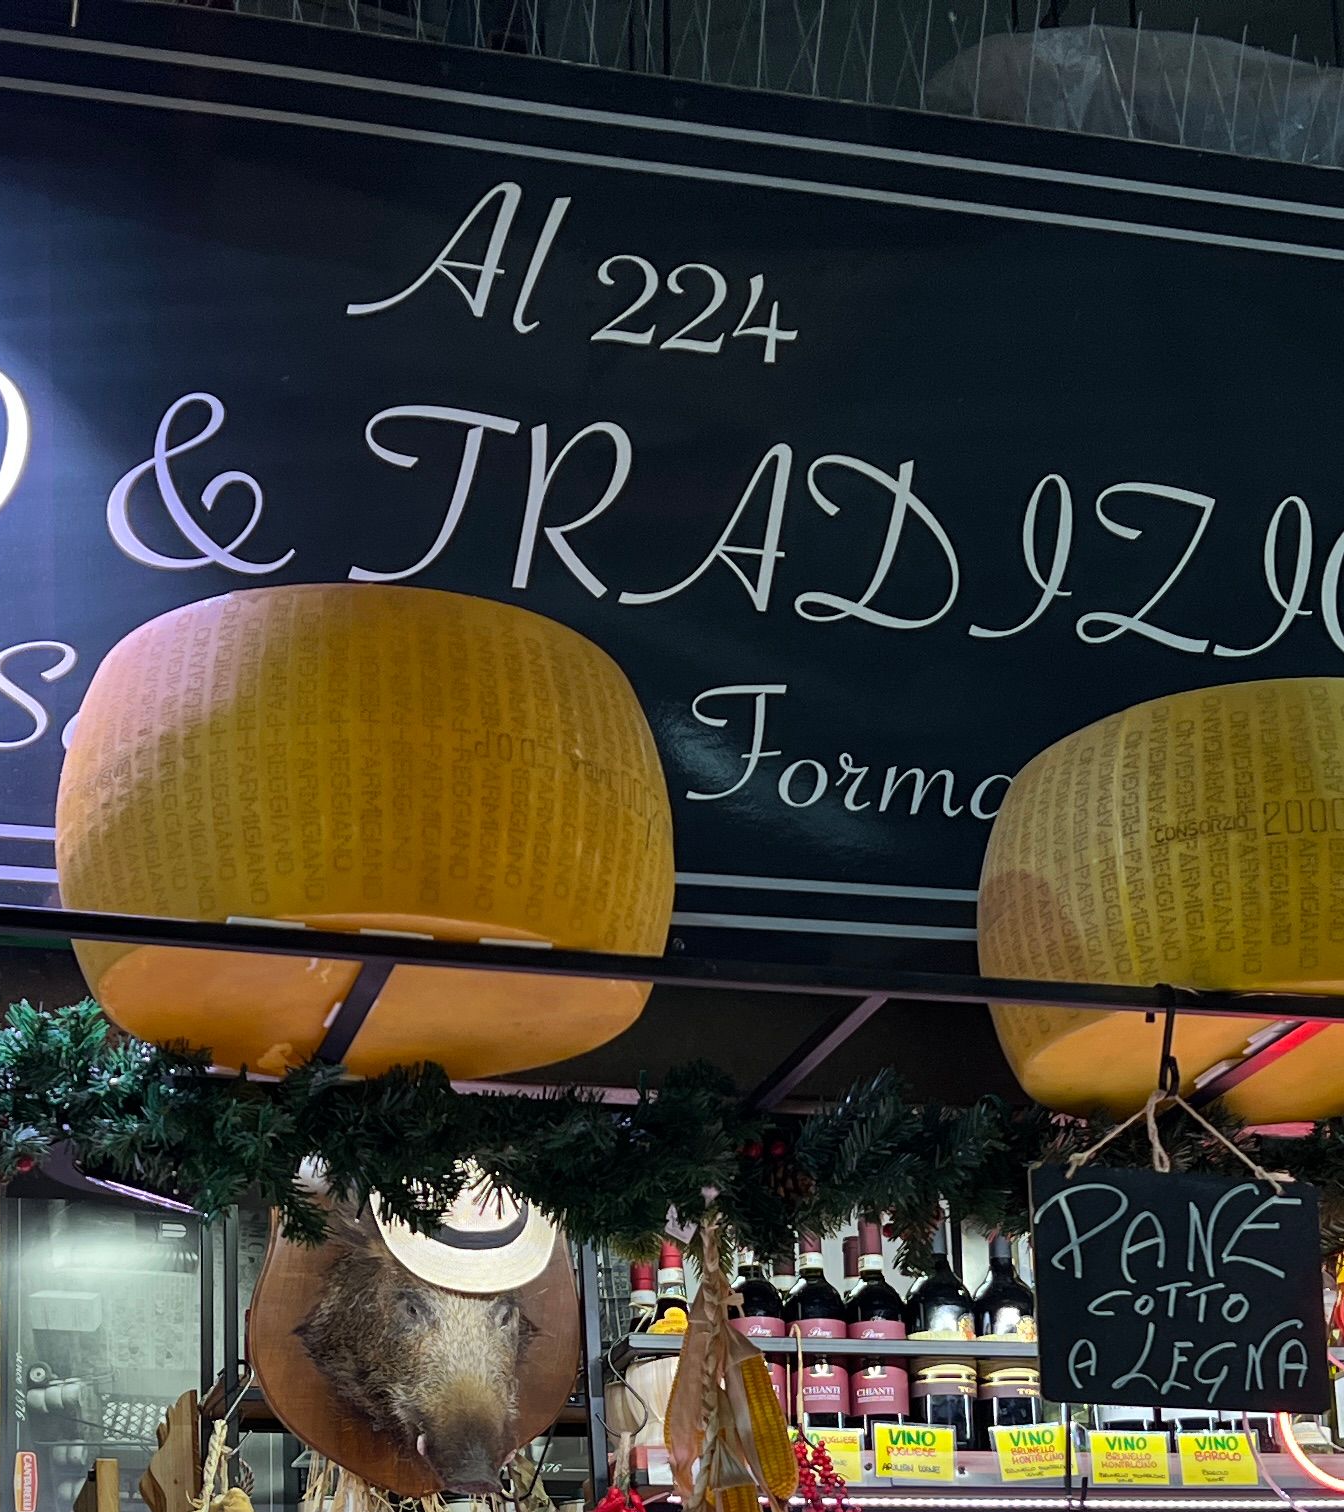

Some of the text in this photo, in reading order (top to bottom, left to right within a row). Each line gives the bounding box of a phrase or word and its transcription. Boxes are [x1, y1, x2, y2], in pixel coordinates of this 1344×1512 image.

[345, 180, 798, 366] Al 224
[106, 391, 296, 573] &
[685, 680, 1014, 826] Forma
[1155, 814, 1248, 844] CONSORZIO
[1035, 1182, 1302, 1284] PANE
[1089, 1286, 1250, 1330] COTTO
[1068, 1314, 1312, 1402] A LEGNA
[803, 1384, 842, 1396] CHIANTI
[856, 1386, 895, 1398] CHIANTI
[888, 1428, 936, 1447] VINO
[1009, 1428, 1054, 1447] VINO
[1105, 1435, 1147, 1451] VINO
[1195, 1435, 1239, 1451] VINO
[1195, 1450, 1242, 1462] BAROLO
